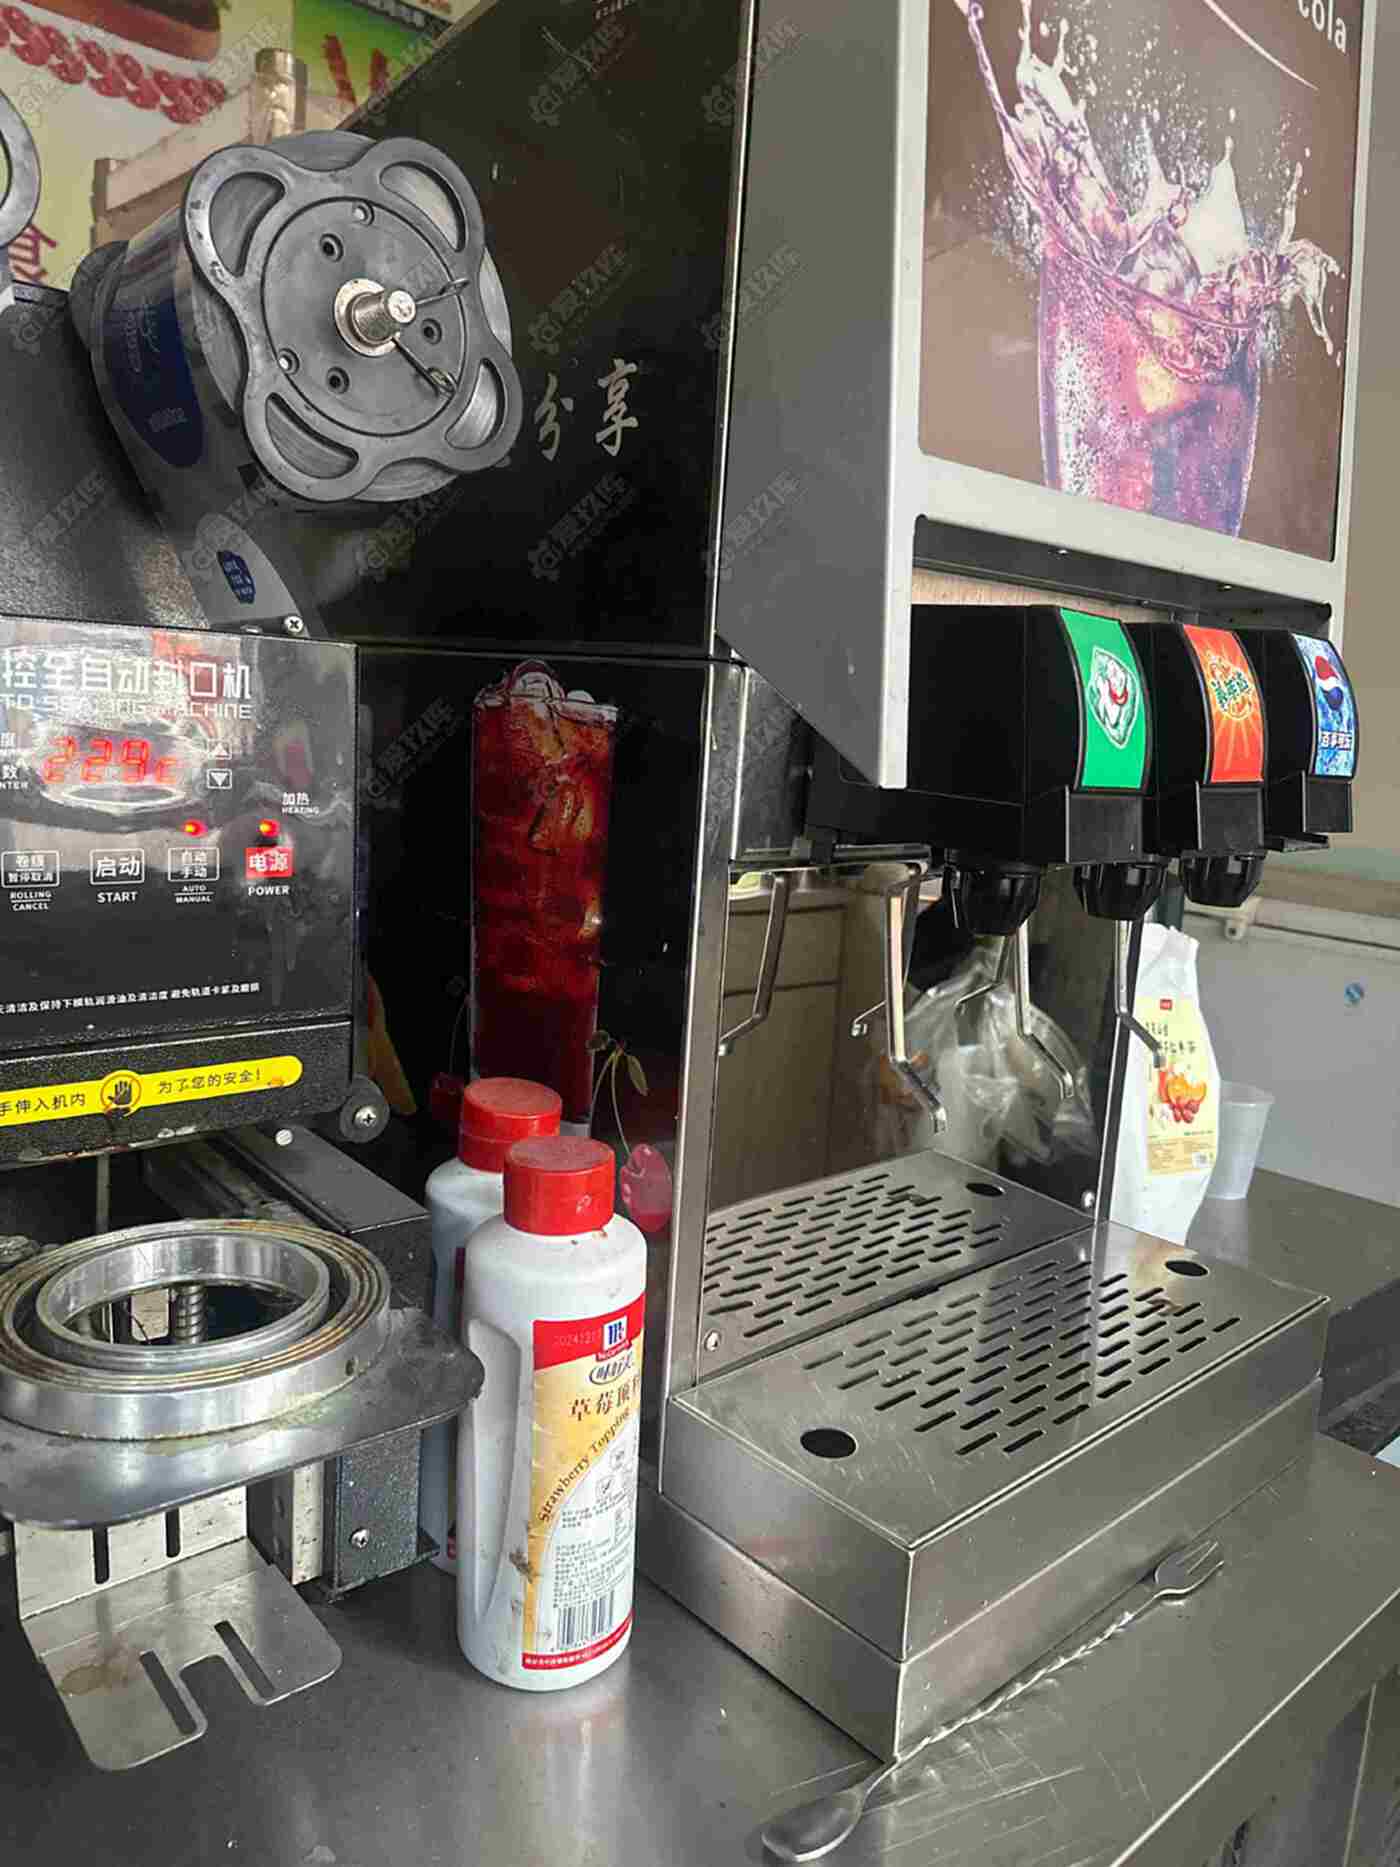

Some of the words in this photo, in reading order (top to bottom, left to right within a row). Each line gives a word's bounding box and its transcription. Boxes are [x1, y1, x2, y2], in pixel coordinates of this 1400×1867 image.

[534, 358, 639, 462] 分享
[95, 855, 141, 878] 启动
[248, 850, 289, 872] 电源
[182, 865, 208, 879] 手动
[10, 890, 52, 899] ROLLING
[182, 884, 207, 892] AUTO
[247, 885, 291, 896] POWER
[97, 891, 138, 904] START
[175, 896, 212, 904] MANUAL
[12, 902, 49, 911] CANCEL
[536, 1454, 591, 1523] Strawberry
